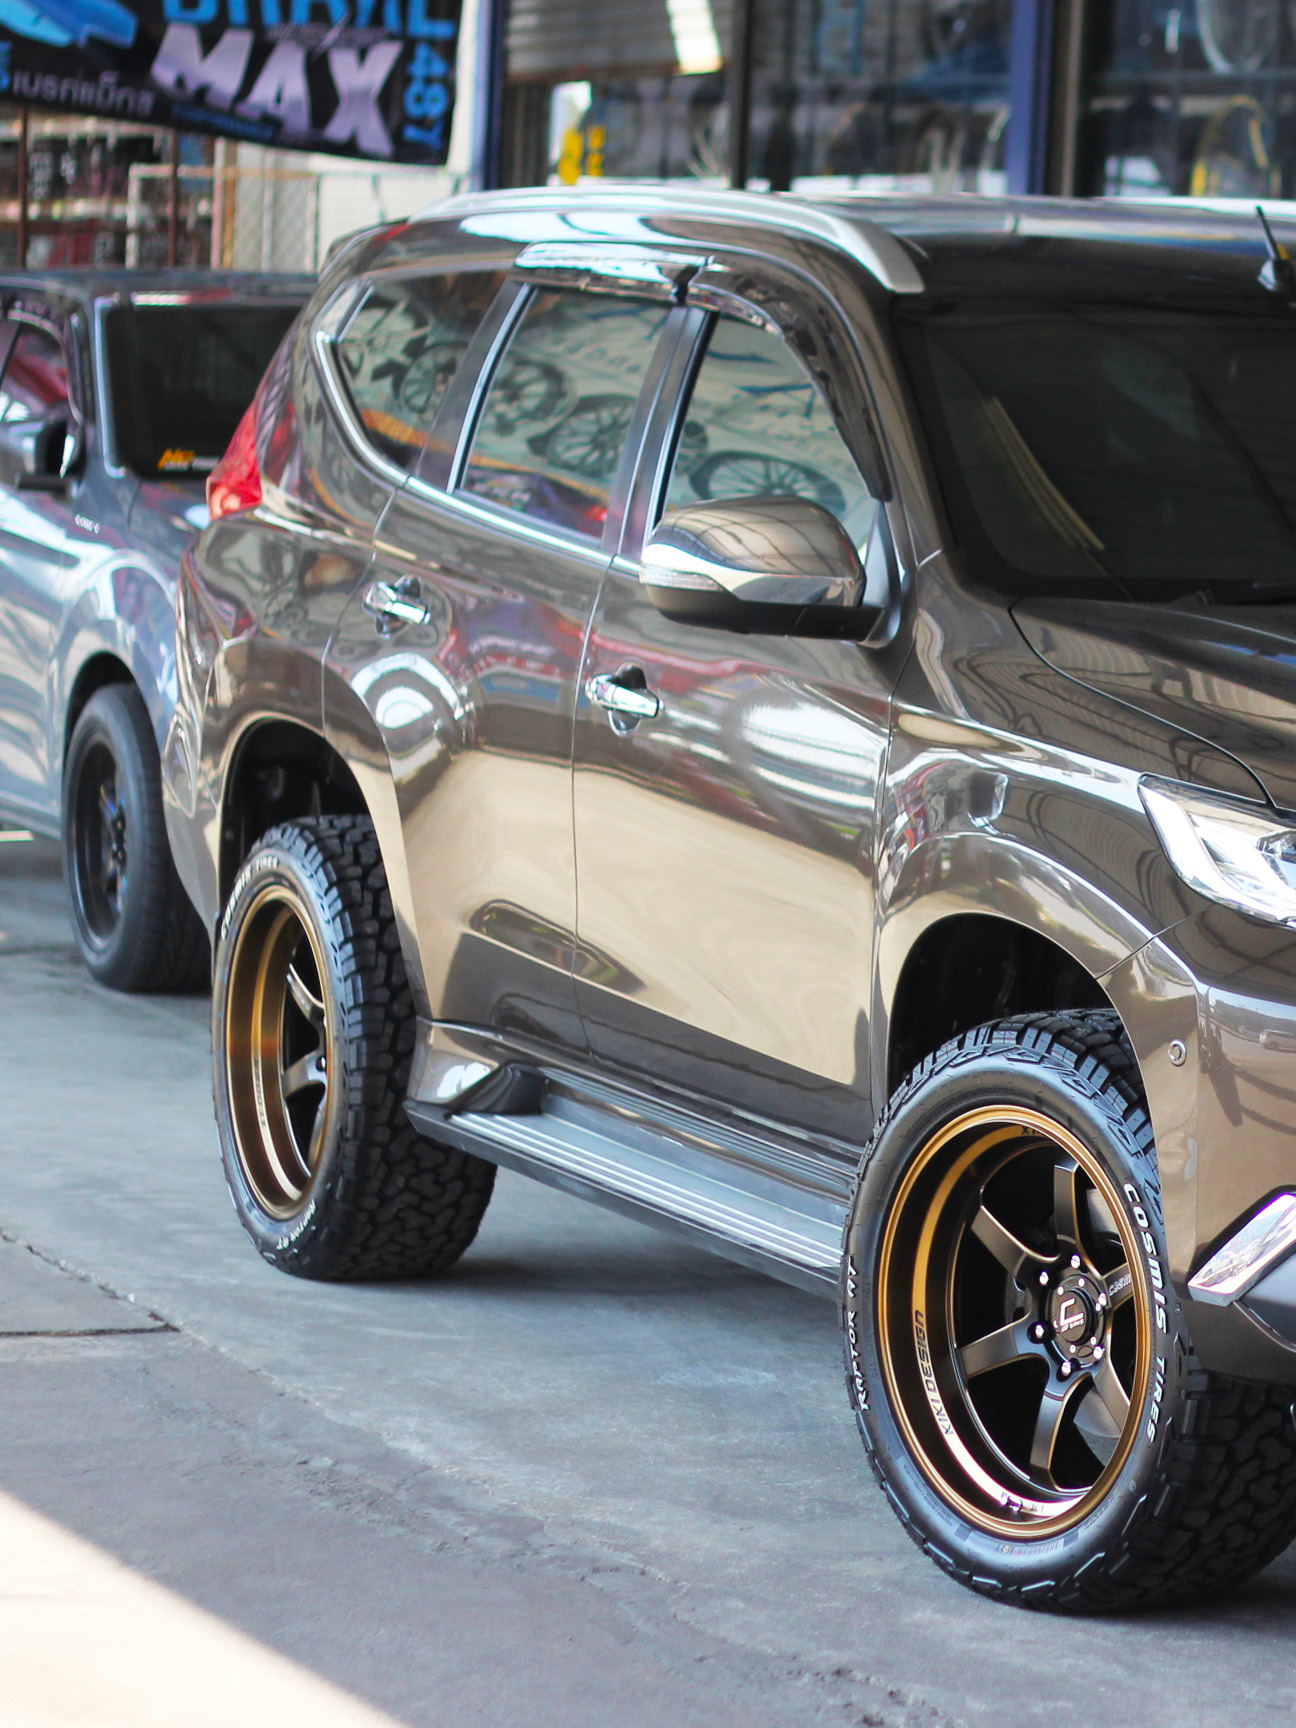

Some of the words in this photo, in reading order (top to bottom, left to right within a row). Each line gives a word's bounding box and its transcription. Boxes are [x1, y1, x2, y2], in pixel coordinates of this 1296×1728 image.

[151, 22, 404, 158] MAX
[848, 1310, 870, 1411] RAPTOR
[914, 1309, 937, 1393] DESIGN
[1123, 1183, 1167, 1334] COSMIS
[1147, 1356, 1167, 1443] TIRES
